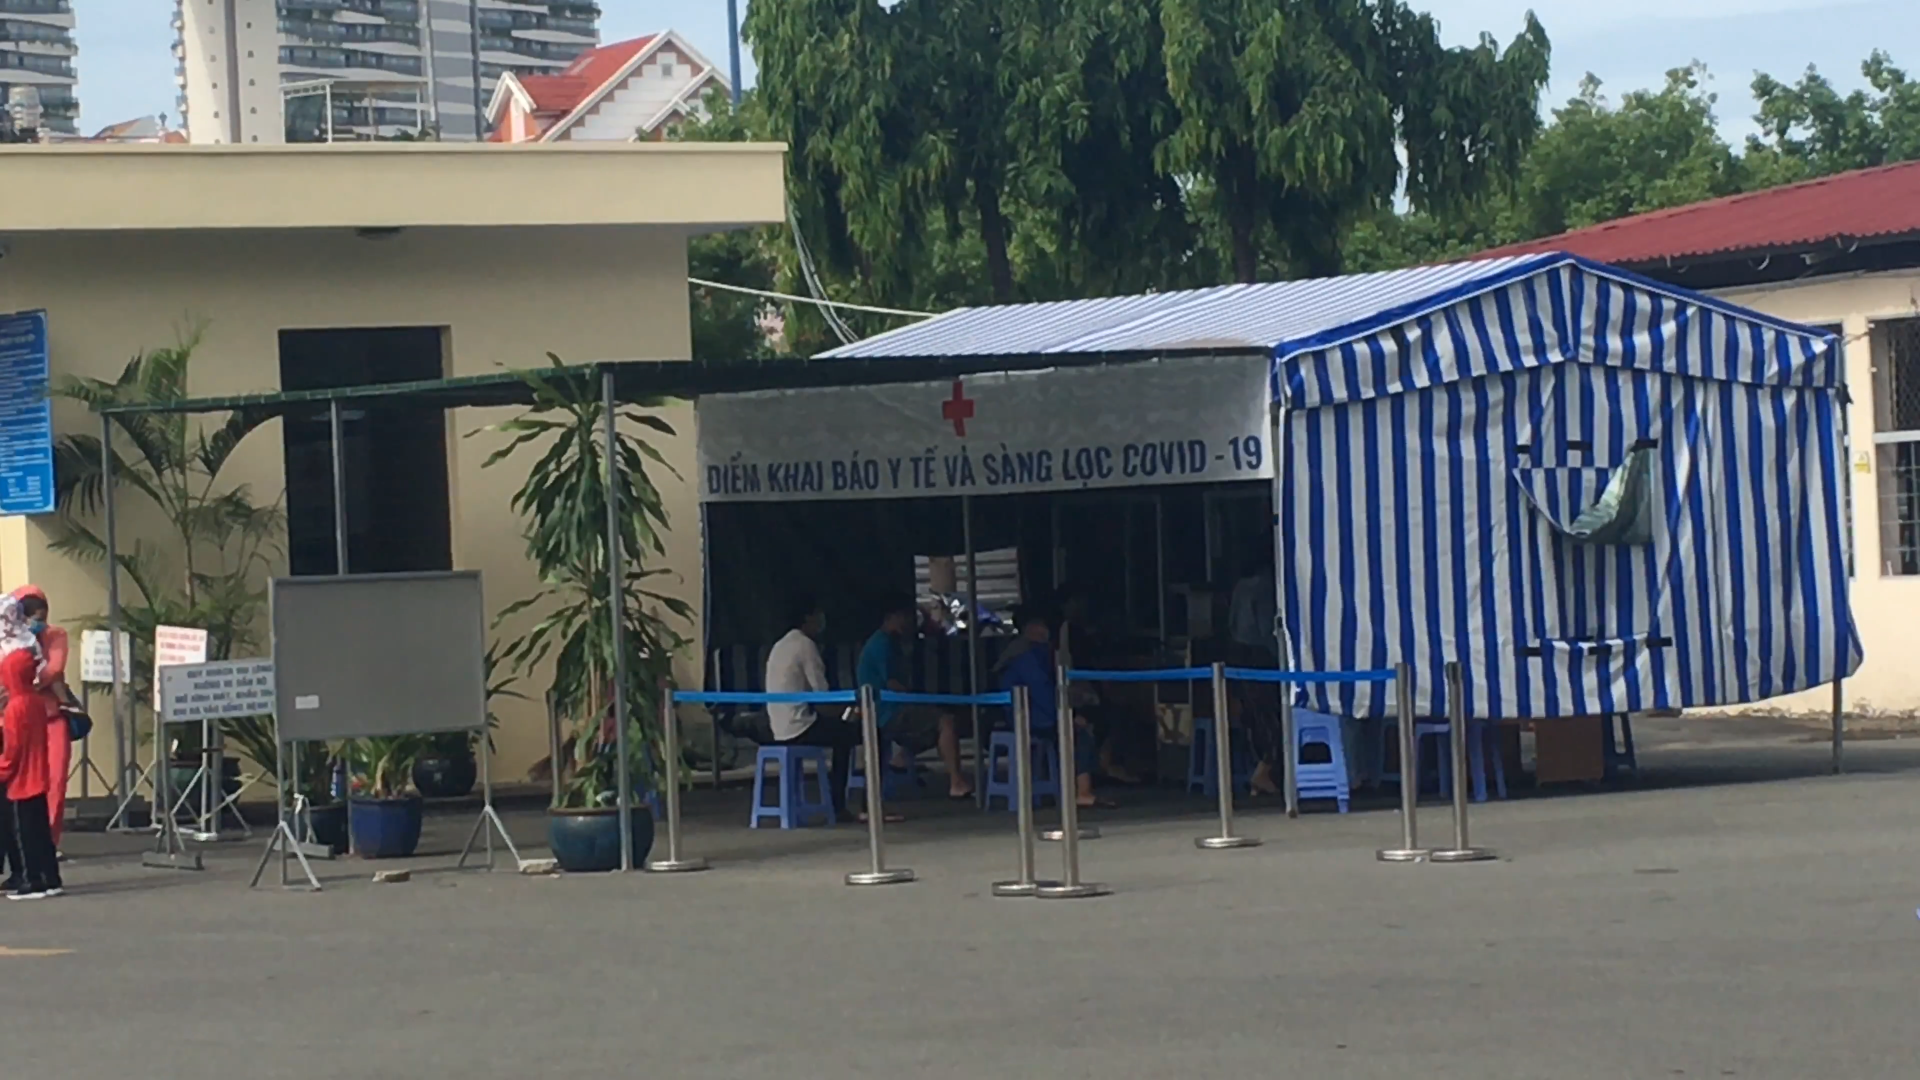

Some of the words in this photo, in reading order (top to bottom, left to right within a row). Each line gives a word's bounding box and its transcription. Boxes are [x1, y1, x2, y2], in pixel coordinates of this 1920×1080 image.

[767, 461, 824, 493] KHAI
[831, 449, 879, 491] BÁO
[888, 457, 901, 489] Y
[909, 444, 938, 488] TẾ
[944, 445, 976, 487] VÀ
[982, 443, 1053, 486] SÀNG
[1062, 446, 1113, 488] LỌC
[1122, 439, 1207, 478] COVID
